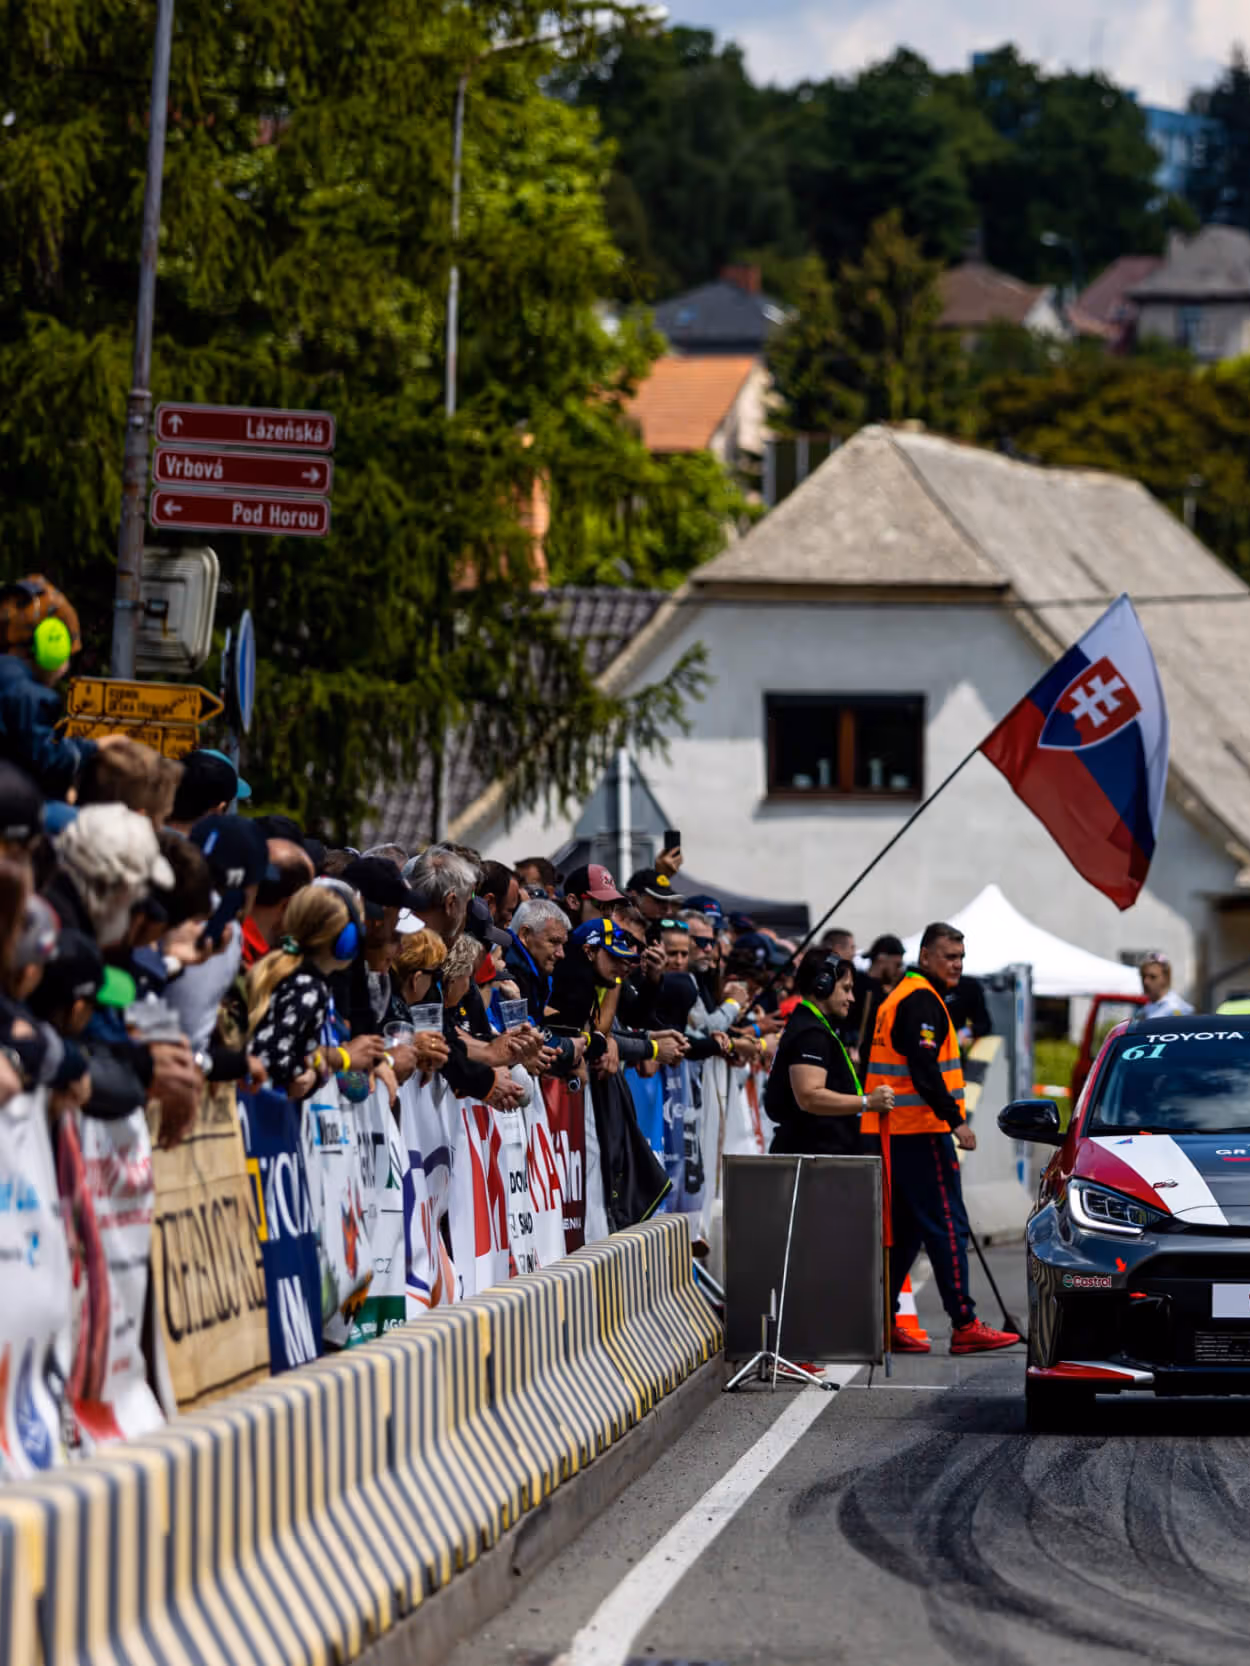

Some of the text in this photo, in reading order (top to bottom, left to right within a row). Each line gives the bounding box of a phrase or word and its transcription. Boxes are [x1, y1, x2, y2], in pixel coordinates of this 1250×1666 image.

[246, 416, 324, 443] Lázeňská
[165, 454, 224, 480] Vrbová
[232, 501, 319, 528] Pod Horou
[1146, 1031, 1242, 1044] TOYOTA
[1121, 1043, 1166, 1061] 61
[1073, 1275, 1112, 1288] Castrol
